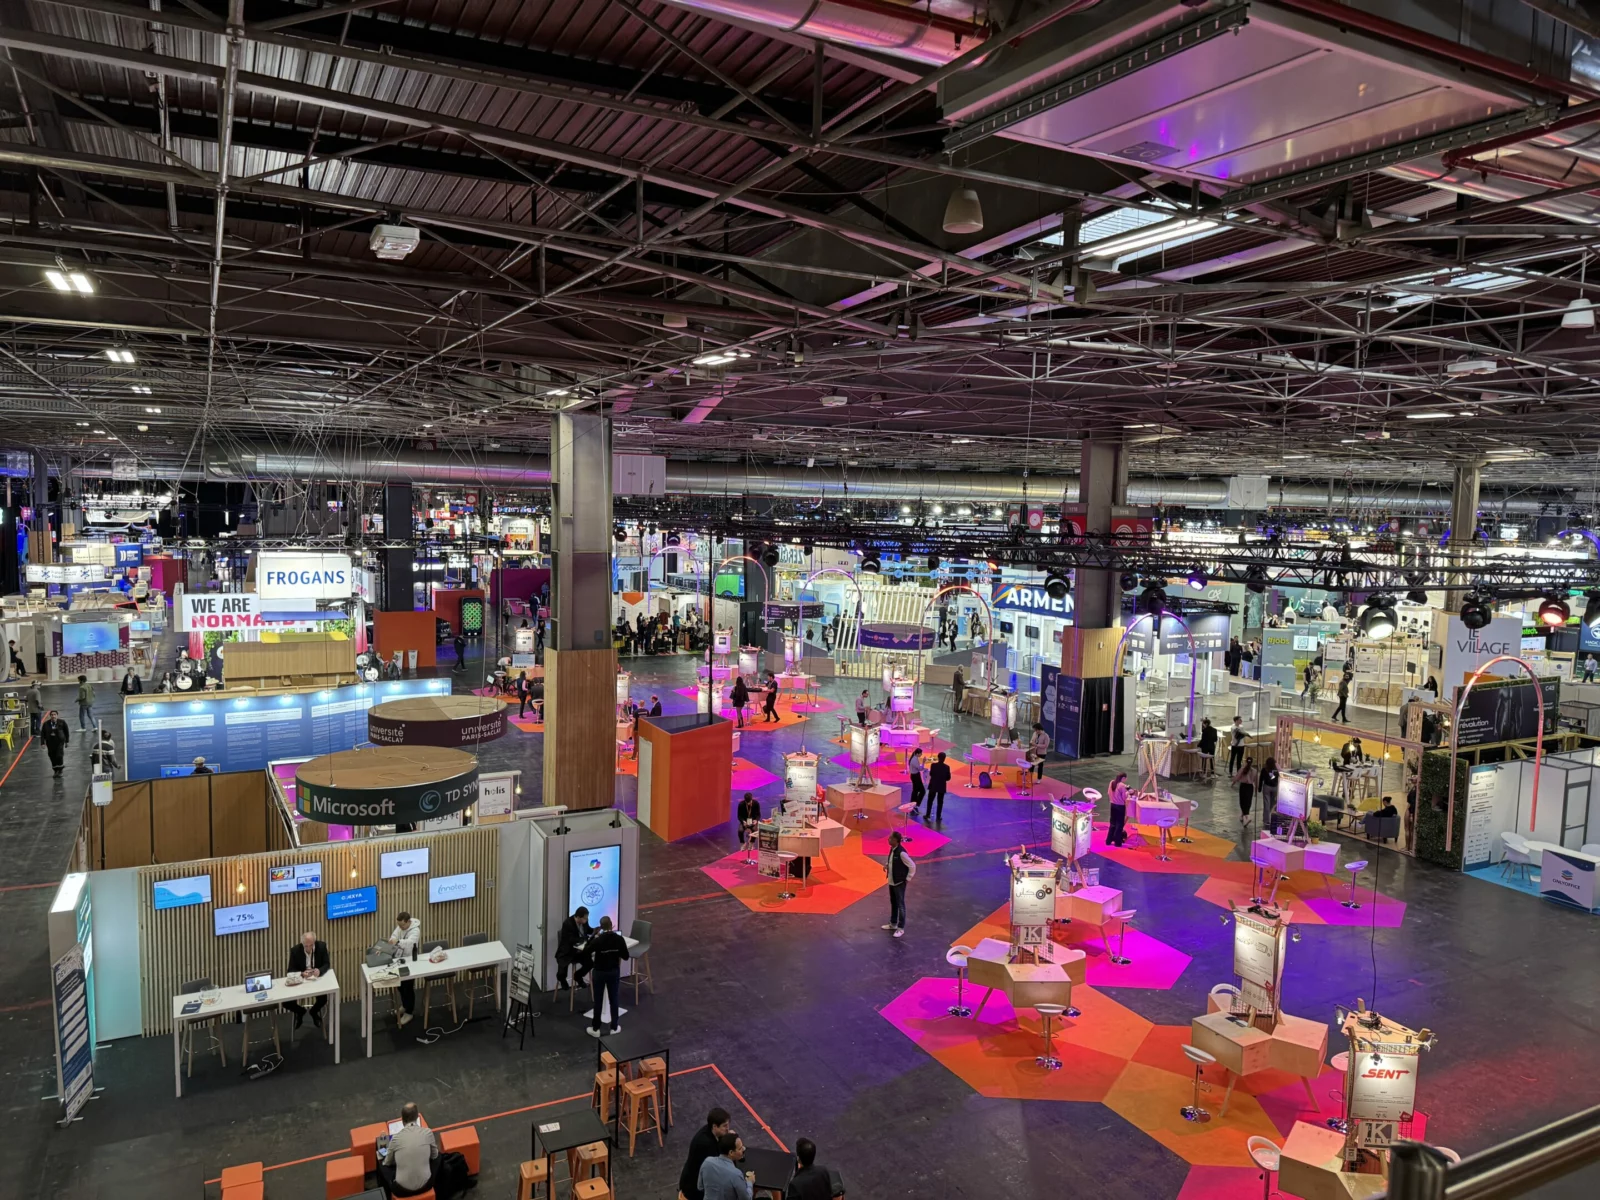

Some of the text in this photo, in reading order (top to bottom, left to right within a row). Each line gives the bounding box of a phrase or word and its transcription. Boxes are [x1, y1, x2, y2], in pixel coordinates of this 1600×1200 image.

[267, 570, 345, 585] FROGANS
[191, 597, 251, 613] WE ARE
[1469, 628, 1480, 640] LE
[1267, 637, 1290, 645] #jobs
[1457, 639, 1510, 655] VILLAGE
[1459, 719, 1489, 728] révolution
[445, 789, 460, 803] TD
[313, 795, 395, 817] Microsoft
[1552, 878, 1580, 890] ONLYOFFICE
[236, 913, 254, 922] 75%
[1365, 1069, 1408, 1079] SENT
